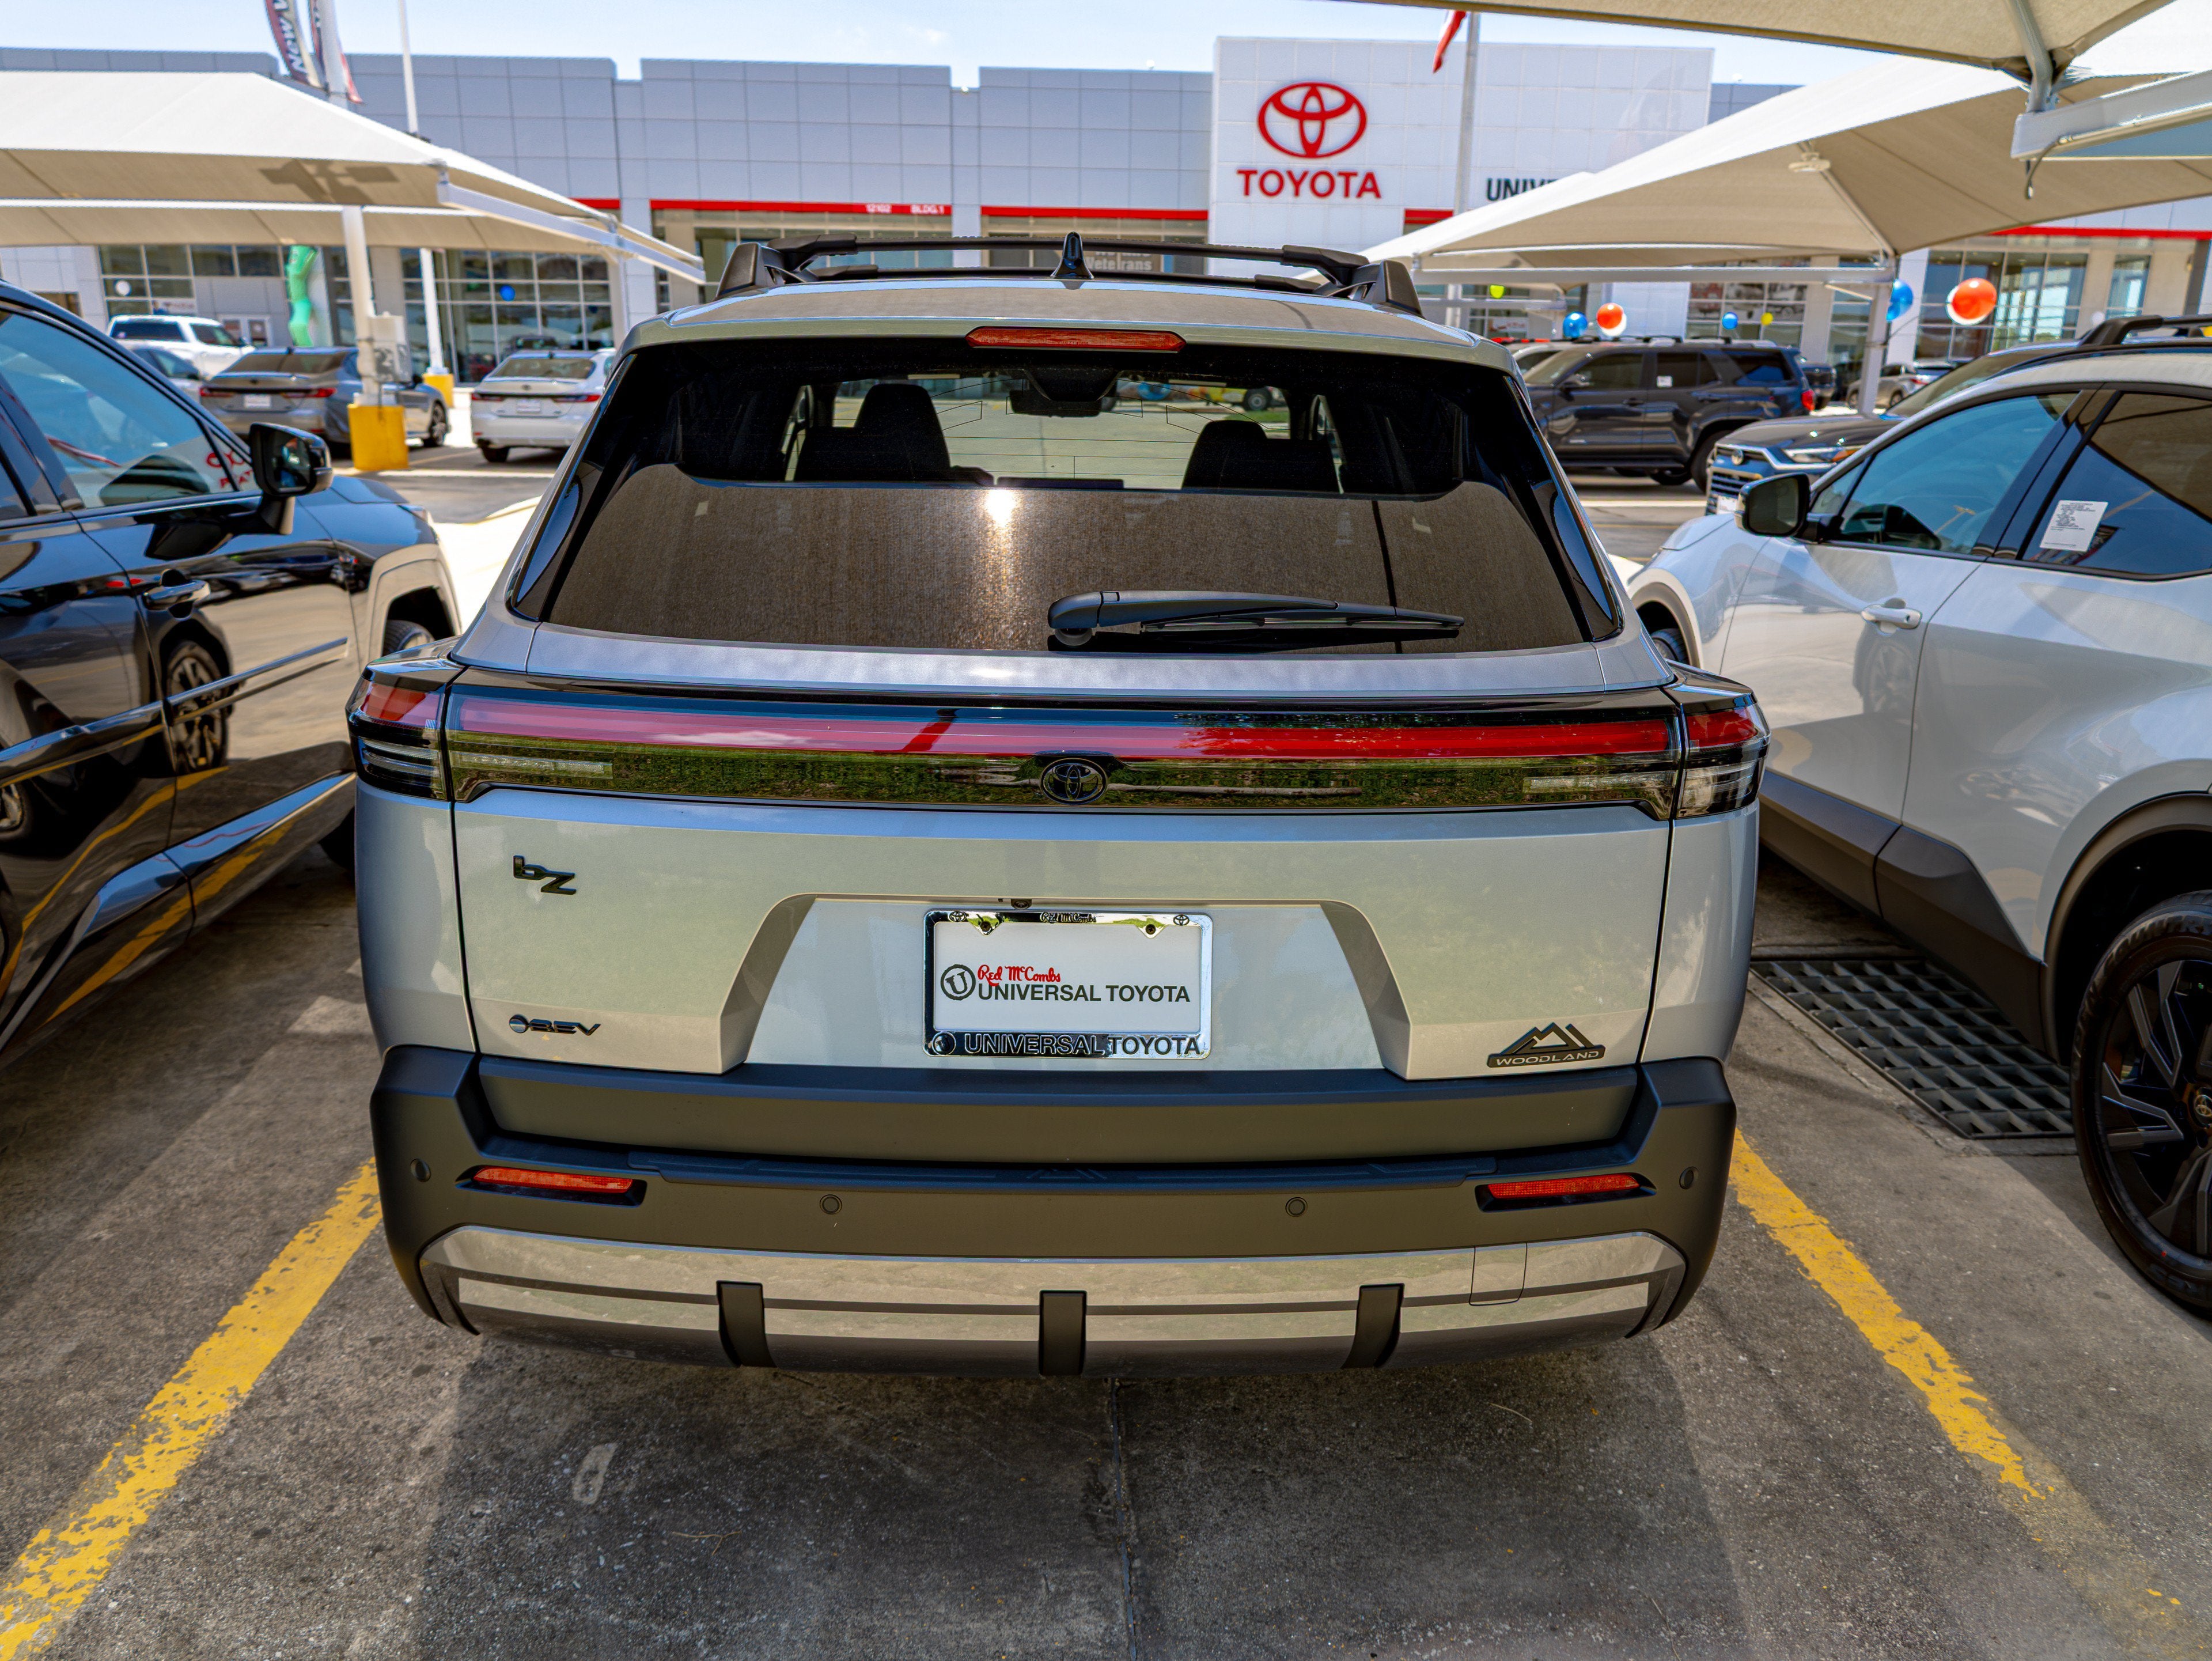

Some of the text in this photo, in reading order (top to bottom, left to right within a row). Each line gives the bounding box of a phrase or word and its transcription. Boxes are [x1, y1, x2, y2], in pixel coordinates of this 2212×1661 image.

[279, 15, 307, 74] New
[1237, 169, 1381, 198] TOYOTA
[978, 964, 1061, 986] Red McCombs
[979, 983, 1191, 1002] UNIVERSAL TOYOTA
[964, 1033, 1105, 1055] UNIVERSAL
[1108, 1036, 1200, 1055] TOYOTA
[1497, 1051, 1599, 1065] WOODLAND
